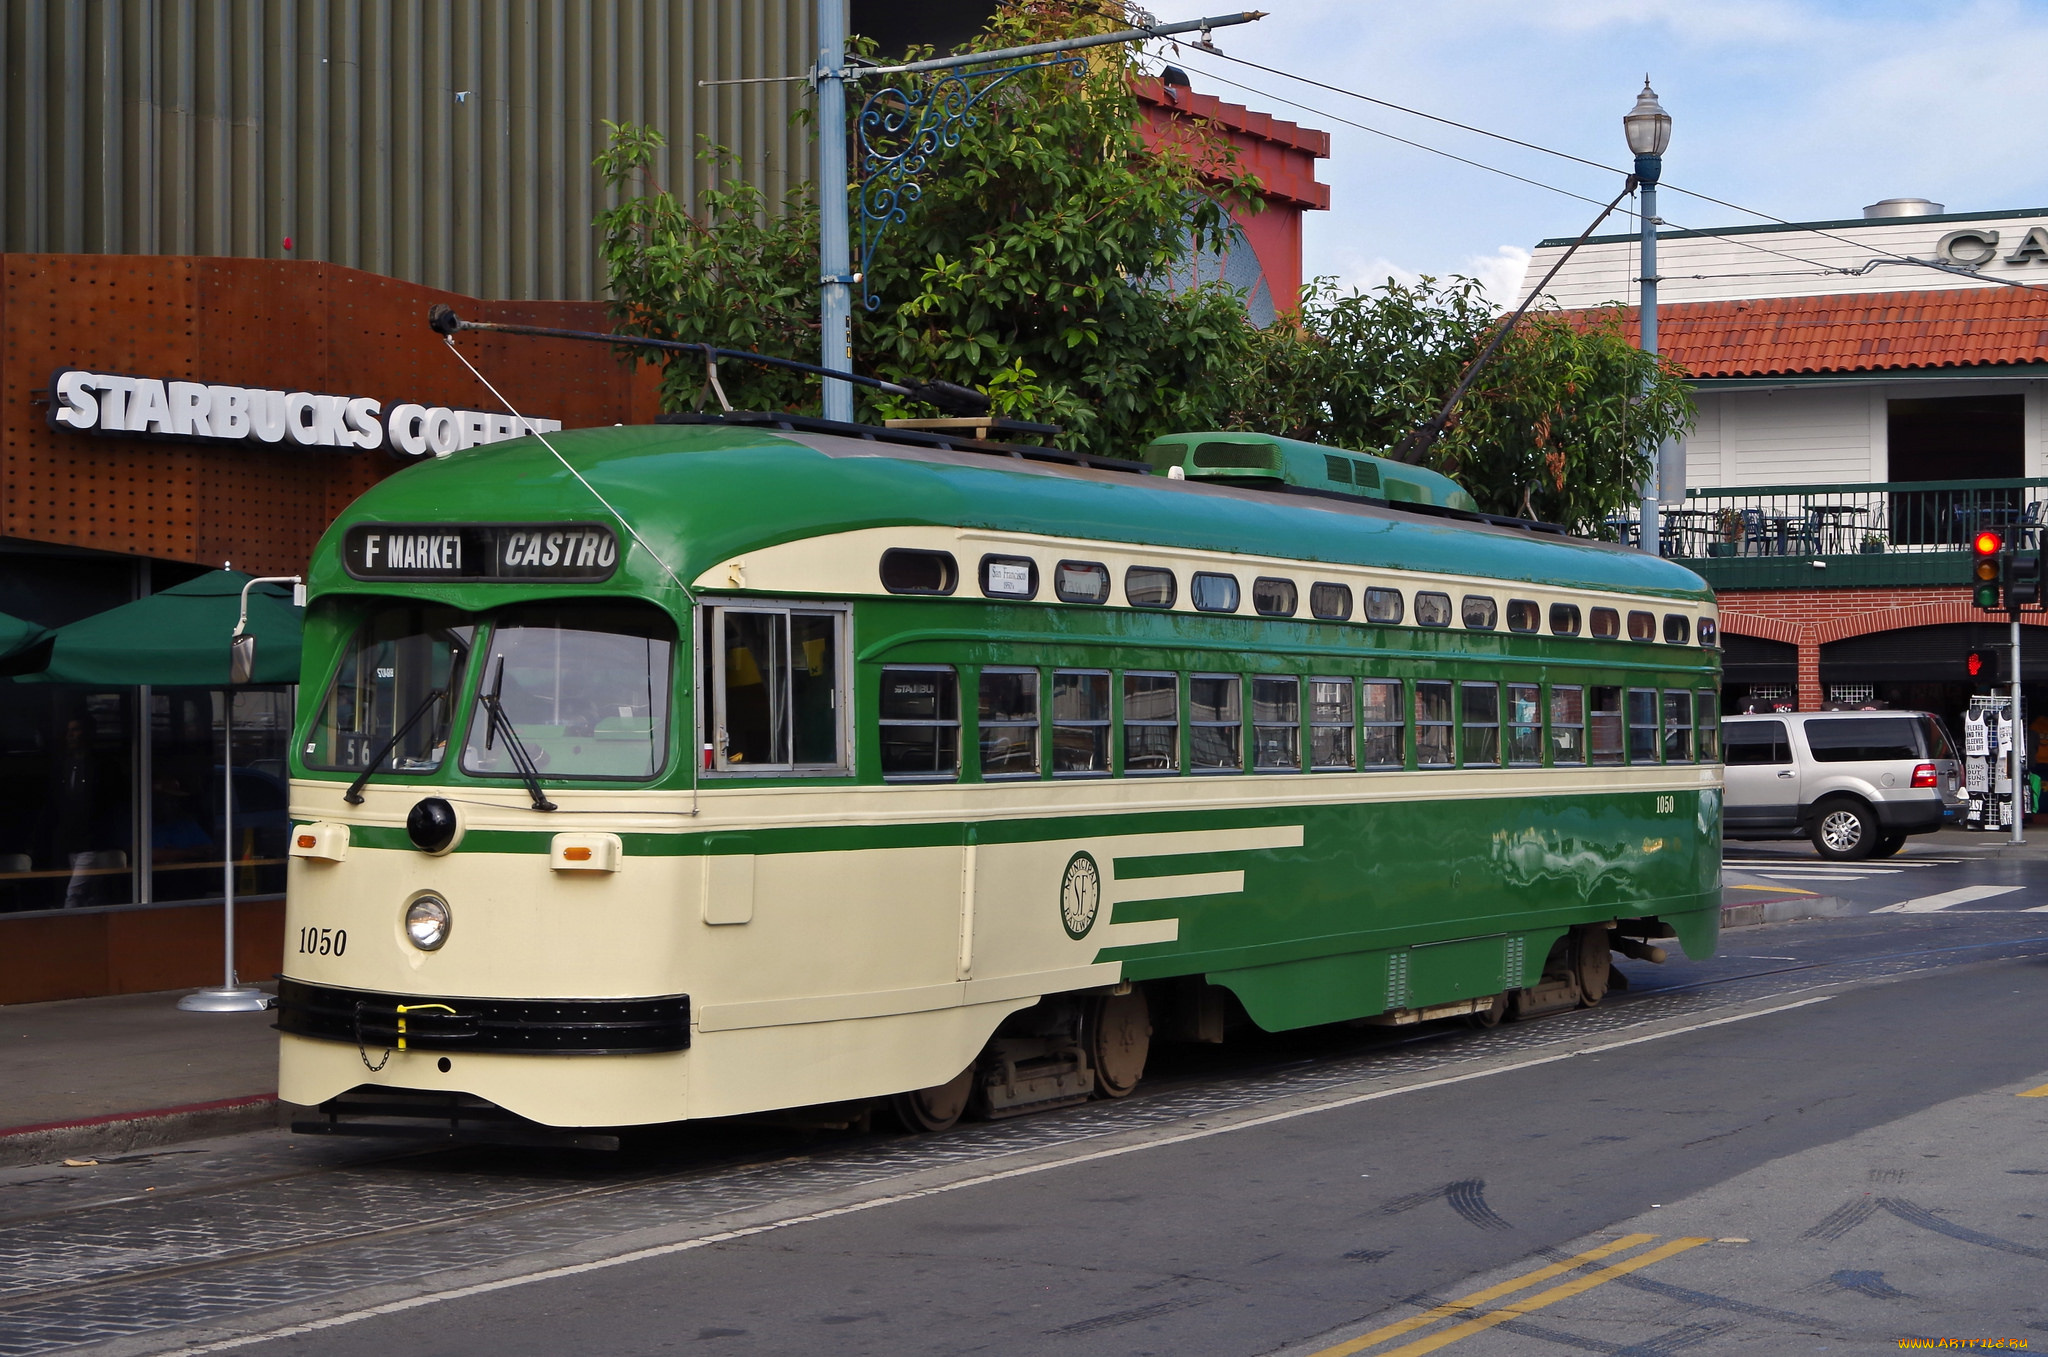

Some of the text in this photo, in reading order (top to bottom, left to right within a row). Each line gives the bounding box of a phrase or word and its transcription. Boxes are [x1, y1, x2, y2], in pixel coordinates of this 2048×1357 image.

[56, 371, 383, 450] STARBUCKS
[366, 535, 381, 568] F
[505, 532, 616, 568] CASTRO
[1656, 795, 1674, 814] 1050
[1064, 859, 1097, 890] MUNICIPAL
[1064, 904, 1095, 932] RAILWAY
[299, 926, 347, 957] 1050
